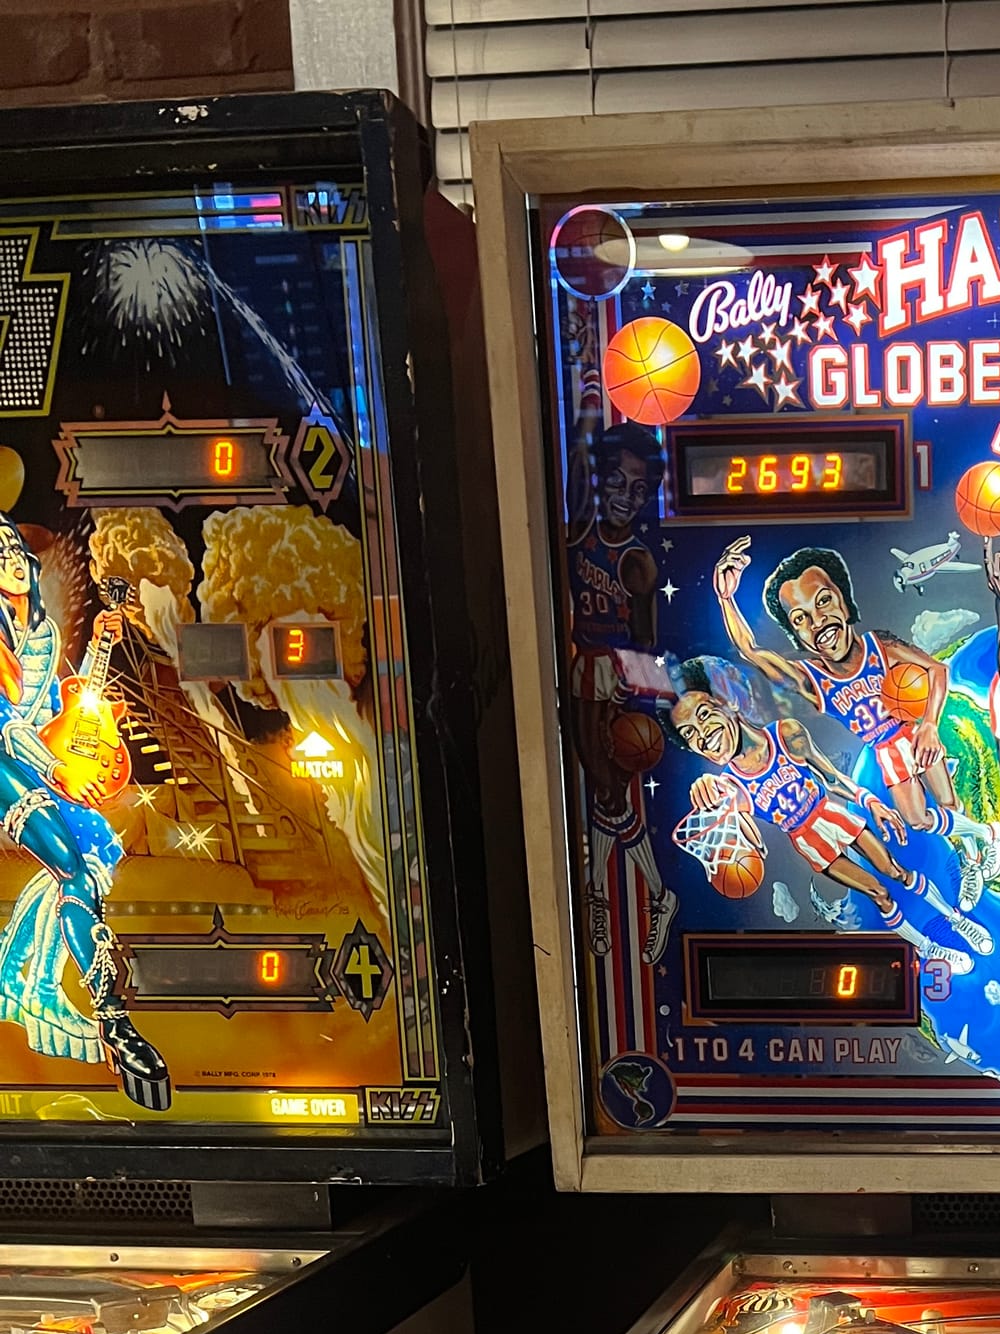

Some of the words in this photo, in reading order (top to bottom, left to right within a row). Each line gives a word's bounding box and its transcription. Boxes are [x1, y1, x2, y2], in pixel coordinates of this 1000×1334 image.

[689, 269, 792, 343] Bally
[214, 441, 233, 476] 0
[303, 426, 336, 488] 2
[727, 455, 843, 493] 2693
[915, 441, 932, 491] 1
[287, 629, 304, 663] 3
[854, 697, 890, 730] 32
[290, 760, 343, 779] MATCH
[777, 781, 808, 813] 42
[262, 951, 279, 981] 0
[345, 945, 382, 998] 4
[837, 965, 857, 996] 0
[923, 959, 952, 1002] 3
[674, 1038, 685, 1062] 1
[697, 1038, 728, 1062] TO
[738, 1038, 755, 1061] 4
[769, 1038, 824, 1063] CAN
[834, 1038, 901, 1064] PLAY
[271, 1097, 309, 1116] GAME
[311, 1098, 346, 1116] OVER
[371, 1090, 434, 1121] KISS
